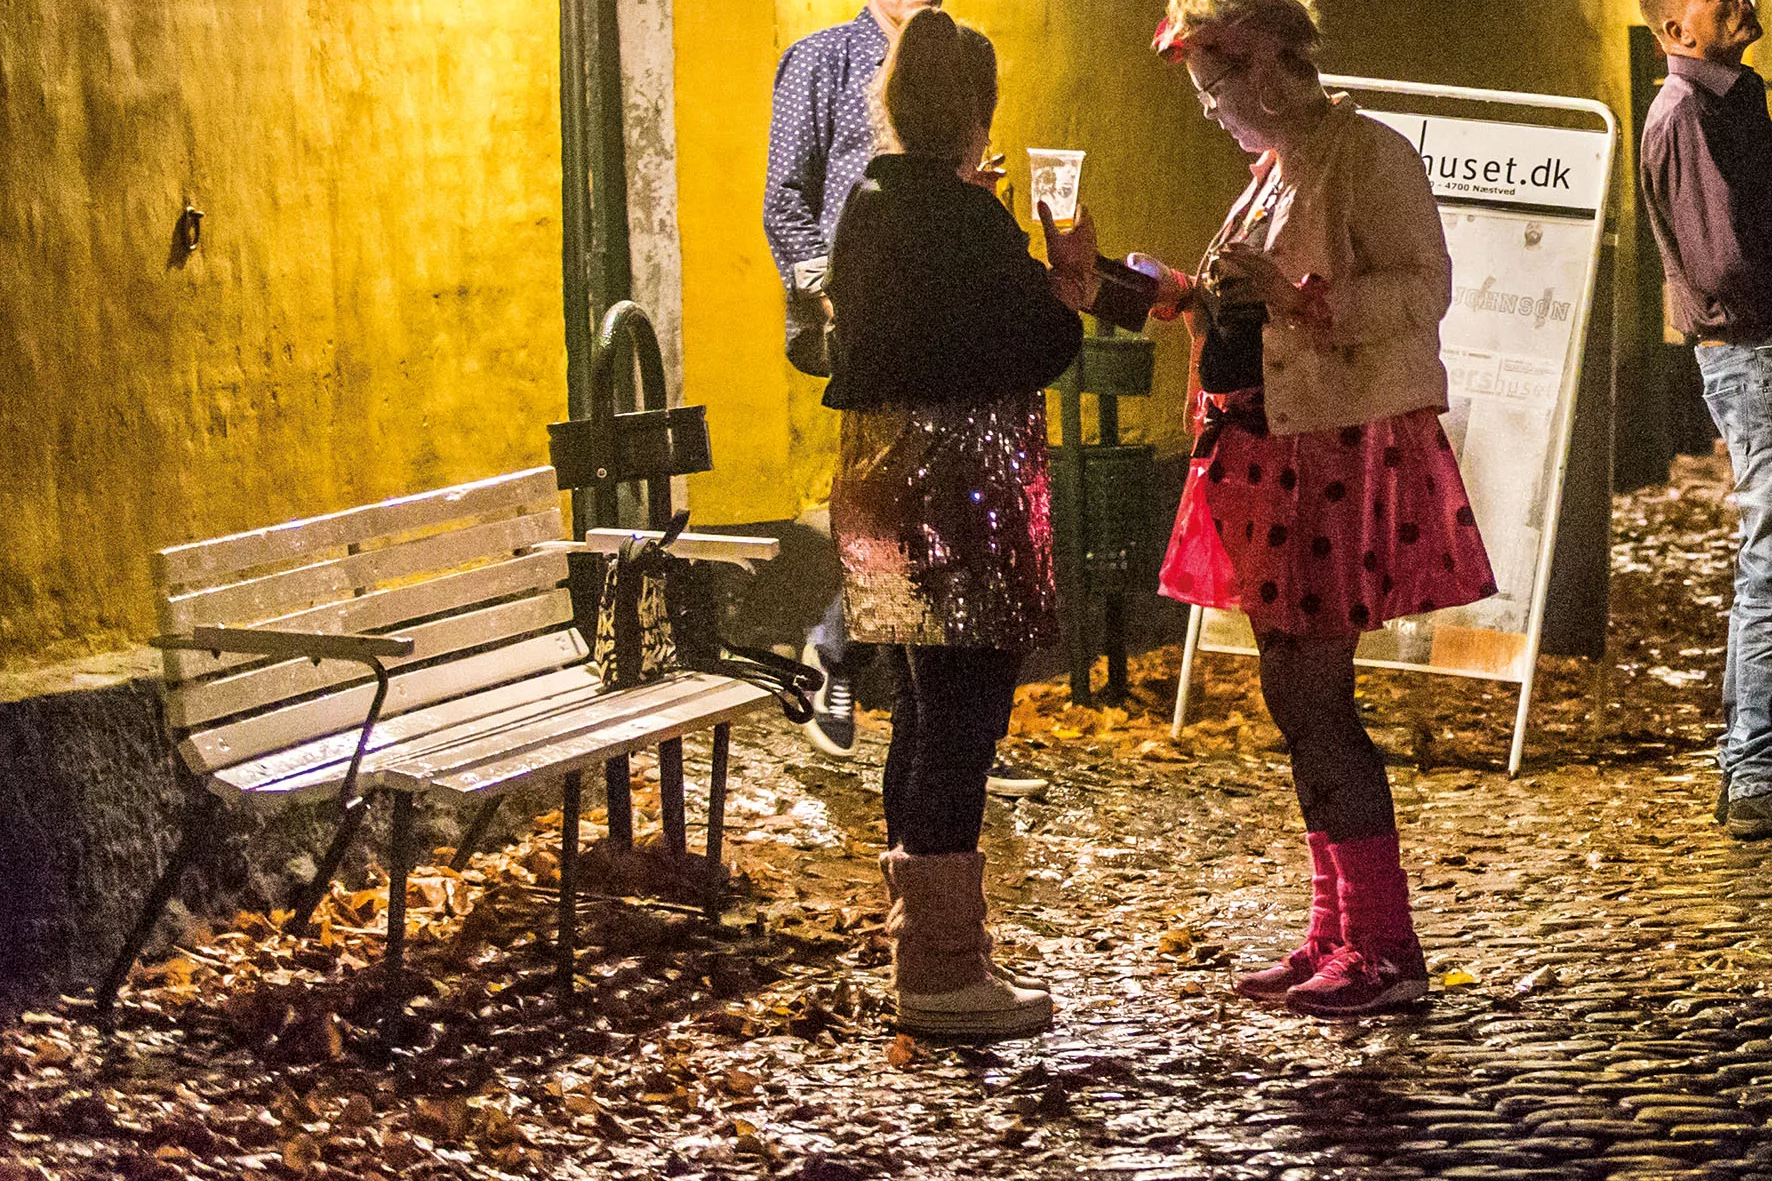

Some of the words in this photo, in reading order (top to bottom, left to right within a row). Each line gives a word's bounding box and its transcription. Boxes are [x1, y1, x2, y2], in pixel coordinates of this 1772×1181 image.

[1444, 181, 1470, 192] 4700
[1472, 184, 1516, 196] Næstved
[1454, 286, 1571, 322] JOHNSON
